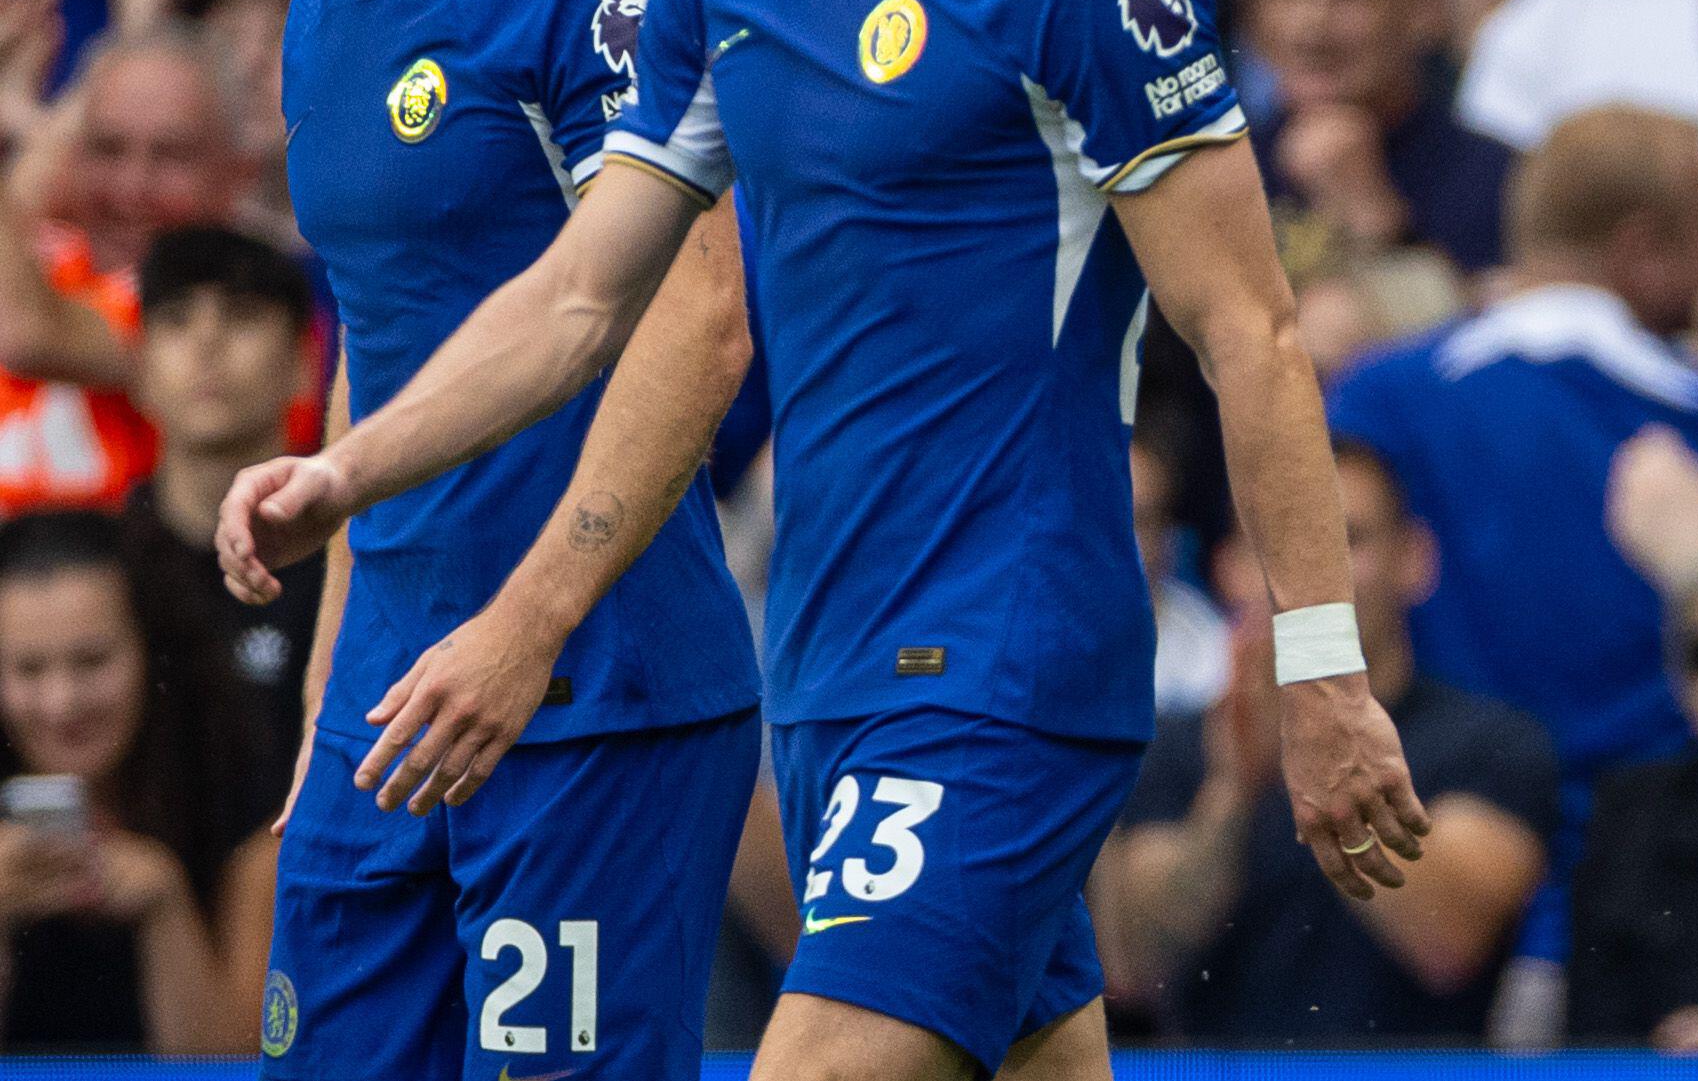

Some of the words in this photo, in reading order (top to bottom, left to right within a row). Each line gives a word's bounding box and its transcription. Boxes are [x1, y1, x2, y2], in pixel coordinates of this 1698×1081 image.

[1145, 76, 1179, 103] No
[1178, 53, 1217, 88] room
[804, 775, 944, 903] 23
[480, 918, 598, 1053] 21
